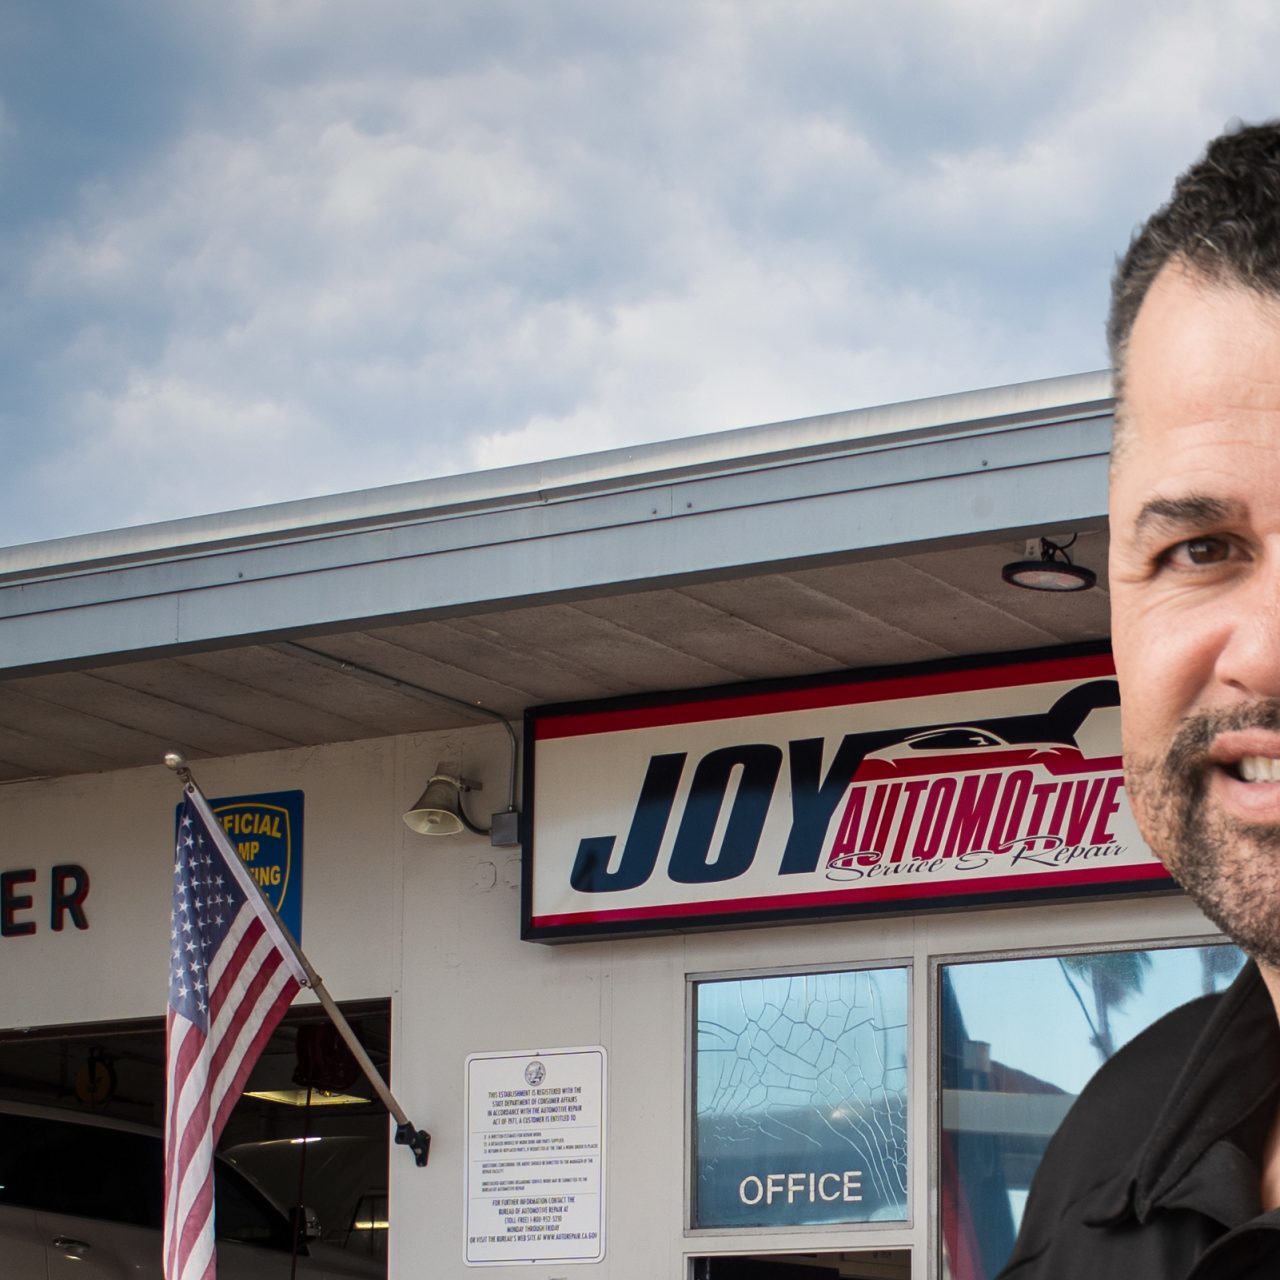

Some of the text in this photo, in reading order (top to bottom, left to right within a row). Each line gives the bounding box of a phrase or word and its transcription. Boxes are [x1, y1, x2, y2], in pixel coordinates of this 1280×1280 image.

[220, 813, 281, 838] FICIAL
[570, 733, 1124, 893] JOY AUTOMOTIVE
[238, 842, 260, 861] MP
[825, 852, 946, 882] Service
[999, 836, 1127, 867] Repair
[739, 1170, 863, 1205] OFFICE
